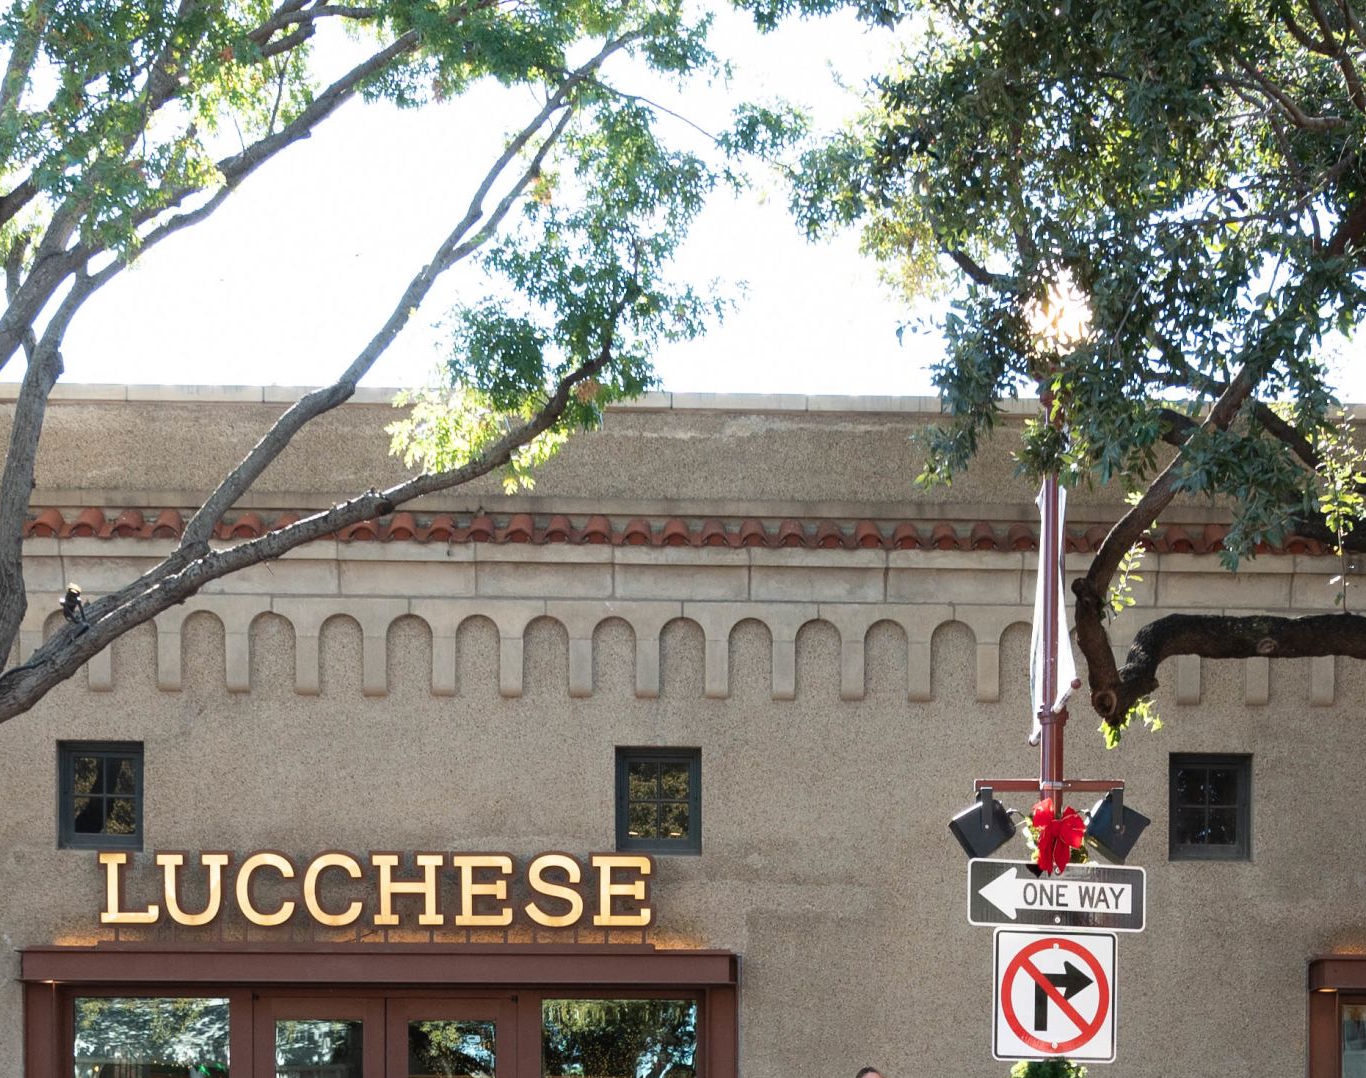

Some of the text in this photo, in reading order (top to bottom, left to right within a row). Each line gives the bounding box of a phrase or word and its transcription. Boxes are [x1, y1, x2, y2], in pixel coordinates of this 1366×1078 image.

[97, 852, 652, 928] LUCCHESE
[1022, 883, 1125, 910] ONE WAY
